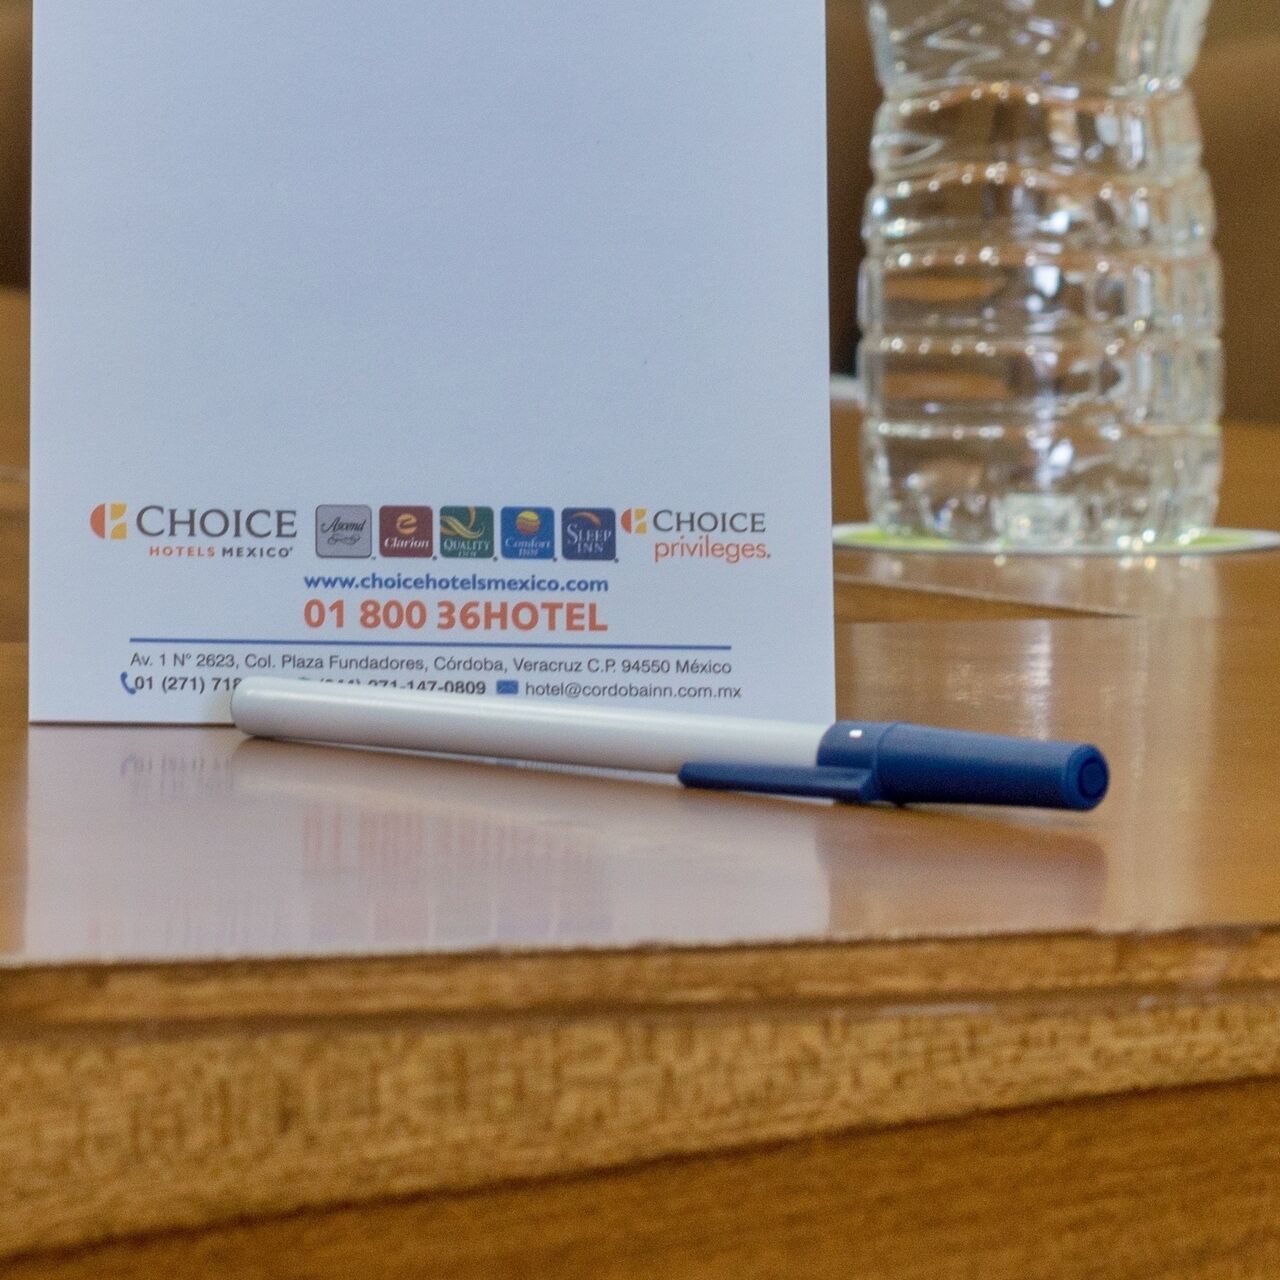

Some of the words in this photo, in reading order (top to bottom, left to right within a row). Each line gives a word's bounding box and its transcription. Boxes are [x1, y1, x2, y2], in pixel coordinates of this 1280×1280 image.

[136, 504, 298, 538] CHOICE
[320, 516, 367, 534] Ascend
[652, 509, 766, 533] CHOICE
[383, 536, 430, 550] Clarion
[504, 536, 552, 549] Comfort
[566, 522, 612, 545] SLEEP
[148, 545, 216, 558] HOTELS
[221, 546, 291, 558] MEXICO
[443, 539, 491, 552] QUALITY
[577, 541, 604, 554] INN
[303, 572, 609, 593] www.choicehotelsmexico.com
[303, 598, 345, 629] 01
[359, 598, 428, 630] 800
[436, 600, 609, 632] 36HOTEL
[130, 653, 153, 667] Av.
[160, 653, 166, 667] 1
[196, 654, 240, 670] 2623,
[244, 654, 276, 669] Col.
[281, 654, 324, 669] Plaza
[329, 655, 429, 672] Fundadores,
[433, 655, 509, 673] Córdoba,
[513, 658, 582, 672] Veracruz
[621, 659, 671, 674] 94550
[675, 658, 733, 675] México
[134, 677, 154, 690] 01
[161, 677, 206, 694] (271)
[525, 681, 742, 699] hotel@cordobainn.com.mx
